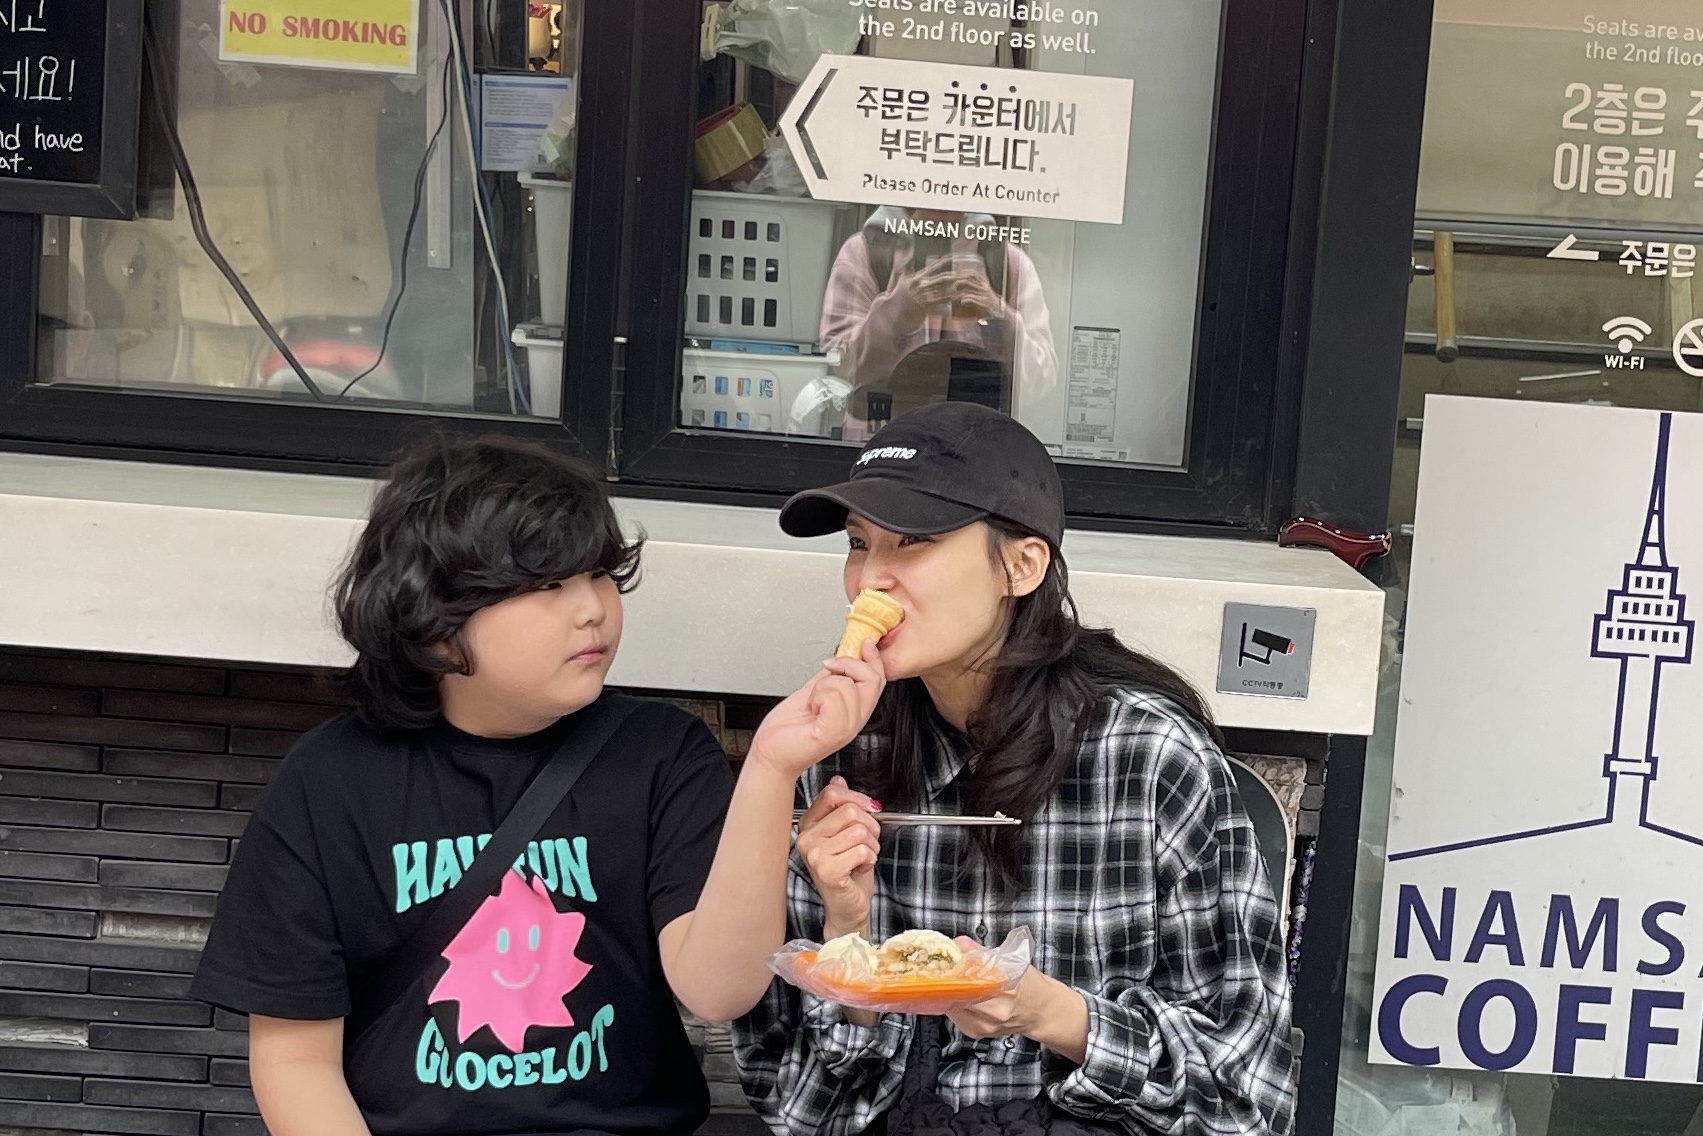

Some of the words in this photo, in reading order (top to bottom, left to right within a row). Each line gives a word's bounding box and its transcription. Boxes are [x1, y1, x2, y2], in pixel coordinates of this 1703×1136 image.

[229, 11, 267, 35] NO
[282, 15, 407, 47] SMOKING
[919, 0, 957, 15] are
[963, 0, 1065, 23] available
[1071, 9, 1099, 26] on
[1583, 15, 1639, 37] Seats
[1644, 24, 1678, 40] are
[858, 15, 895, 37] the
[902, 18, 944, 41] 2nd
[950, 22, 1005, 46] floor
[1010, 31, 1036, 49] as
[1042, 33, 1096, 54] well.
[1585, 41, 1617, 60] the
[1623, 43, 1660, 63] 2nd
[856, 86, 930, 122] 주문은
[942, 91, 1077, 136] 카운터에서
[1562, 82, 1667, 136] 2층은
[35, 125, 83, 151] have
[879, 128, 1047, 173] 부탁드립니다.
[863, 173, 917, 192] Please
[922, 178, 968, 197] Order
[972, 182, 991, 199] At
[995, 184, 1060, 204] Counter
[1553, 142, 1676, 199] 이용해
[884, 218, 959, 239] NAMSAN
[964, 223, 1032, 245] COFFEE
[1619, 240, 1696, 278] 주문은
[1604, 354, 1645, 370] WI-FI
[511, 836, 598, 902] UN
[1394, 884, 1703, 978] NAMS
[1377, 974, 1703, 1083] COFF
